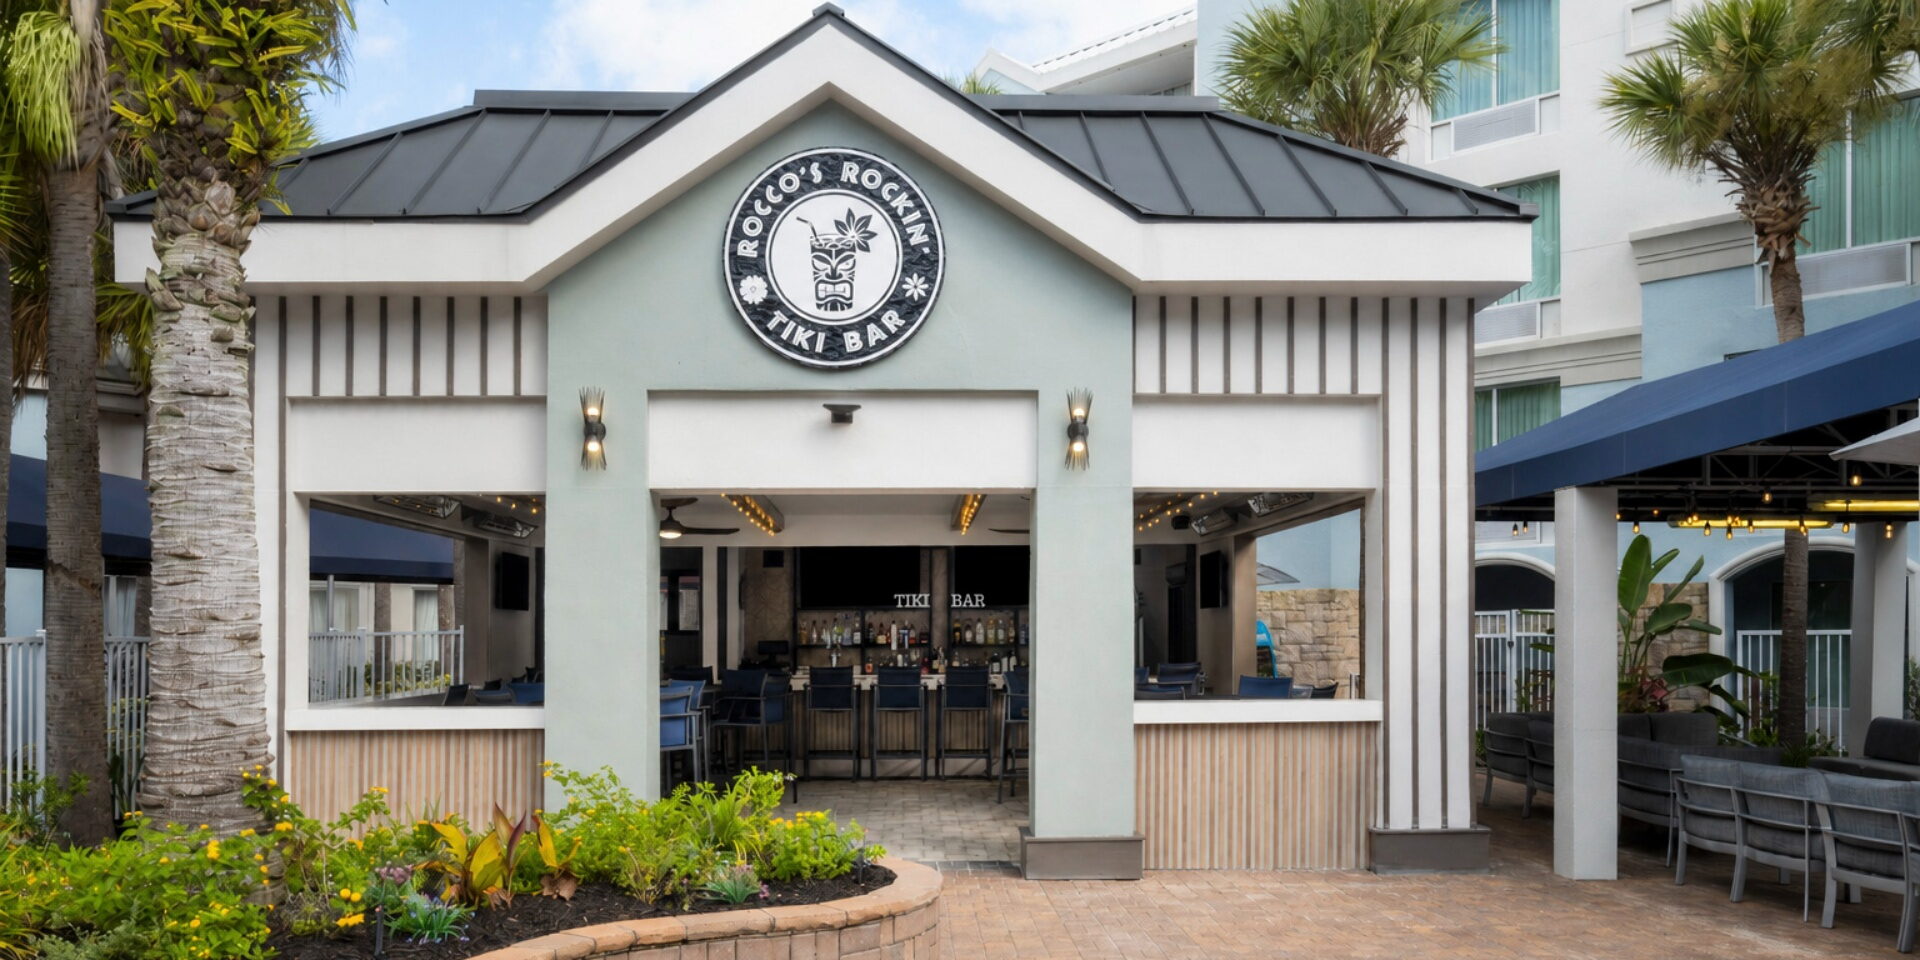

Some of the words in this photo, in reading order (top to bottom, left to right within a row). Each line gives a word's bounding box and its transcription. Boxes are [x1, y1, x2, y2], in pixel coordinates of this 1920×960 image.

[737, 162, 823, 258] ROCCO'S
[840, 161, 931, 255] ROCKIN'
[766, 310, 826, 353] TIKI
[843, 309, 905, 352] BAR
[894, 593, 930, 608] TIKI
[951, 593, 986, 608] BAR
